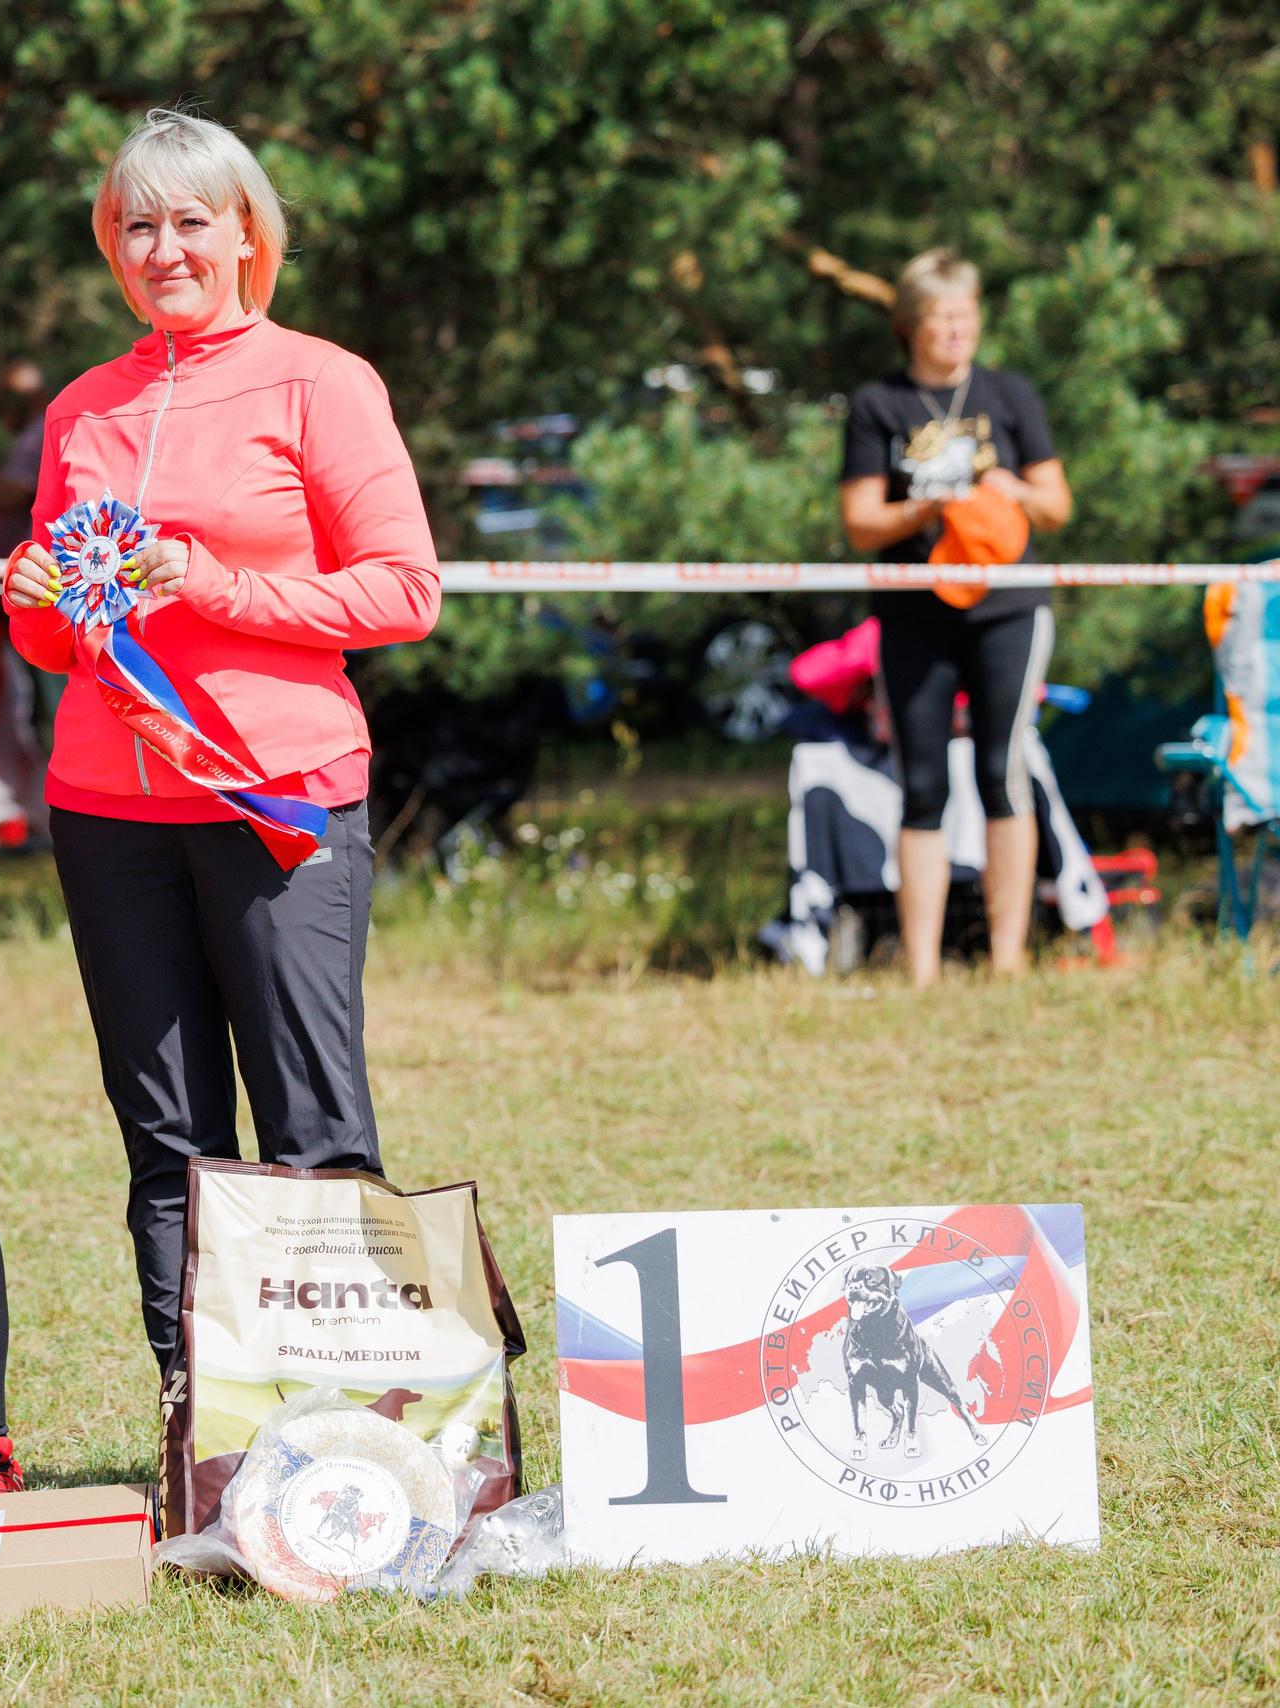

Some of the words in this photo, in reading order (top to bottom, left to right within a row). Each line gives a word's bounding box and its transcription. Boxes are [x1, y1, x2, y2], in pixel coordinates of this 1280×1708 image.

[141, 717, 192, 753] класса
[265, 1226, 300, 1237] взрослых
[301, 1227, 326, 1236] собак
[328, 1228, 360, 1236] мелких
[369, 1229, 400, 1238] средних
[276, 1215, 296, 1225] Корм
[297, 1215, 322, 1226] сухой
[285, 1245, 292, 1255] с
[293, 1242, 356, 1255] говядиной
[358, 1245, 366, 1255] и
[366, 1244, 403, 1257] рисом
[259, 1277, 433, 1310] Hanta
[312, 1314, 381, 1328] premium
[766, 1230, 869, 1433] РОТВЕЙЛЕР
[892, 1224, 987, 1267] КЛУБ
[997, 1275, 1045, 1429] РОССИИ
[278, 1345, 421, 1363] SMALL/MEDIUM
[594, 1228, 727, 1505] 1
[838, 1457, 993, 1504] РКФ-НКПР
